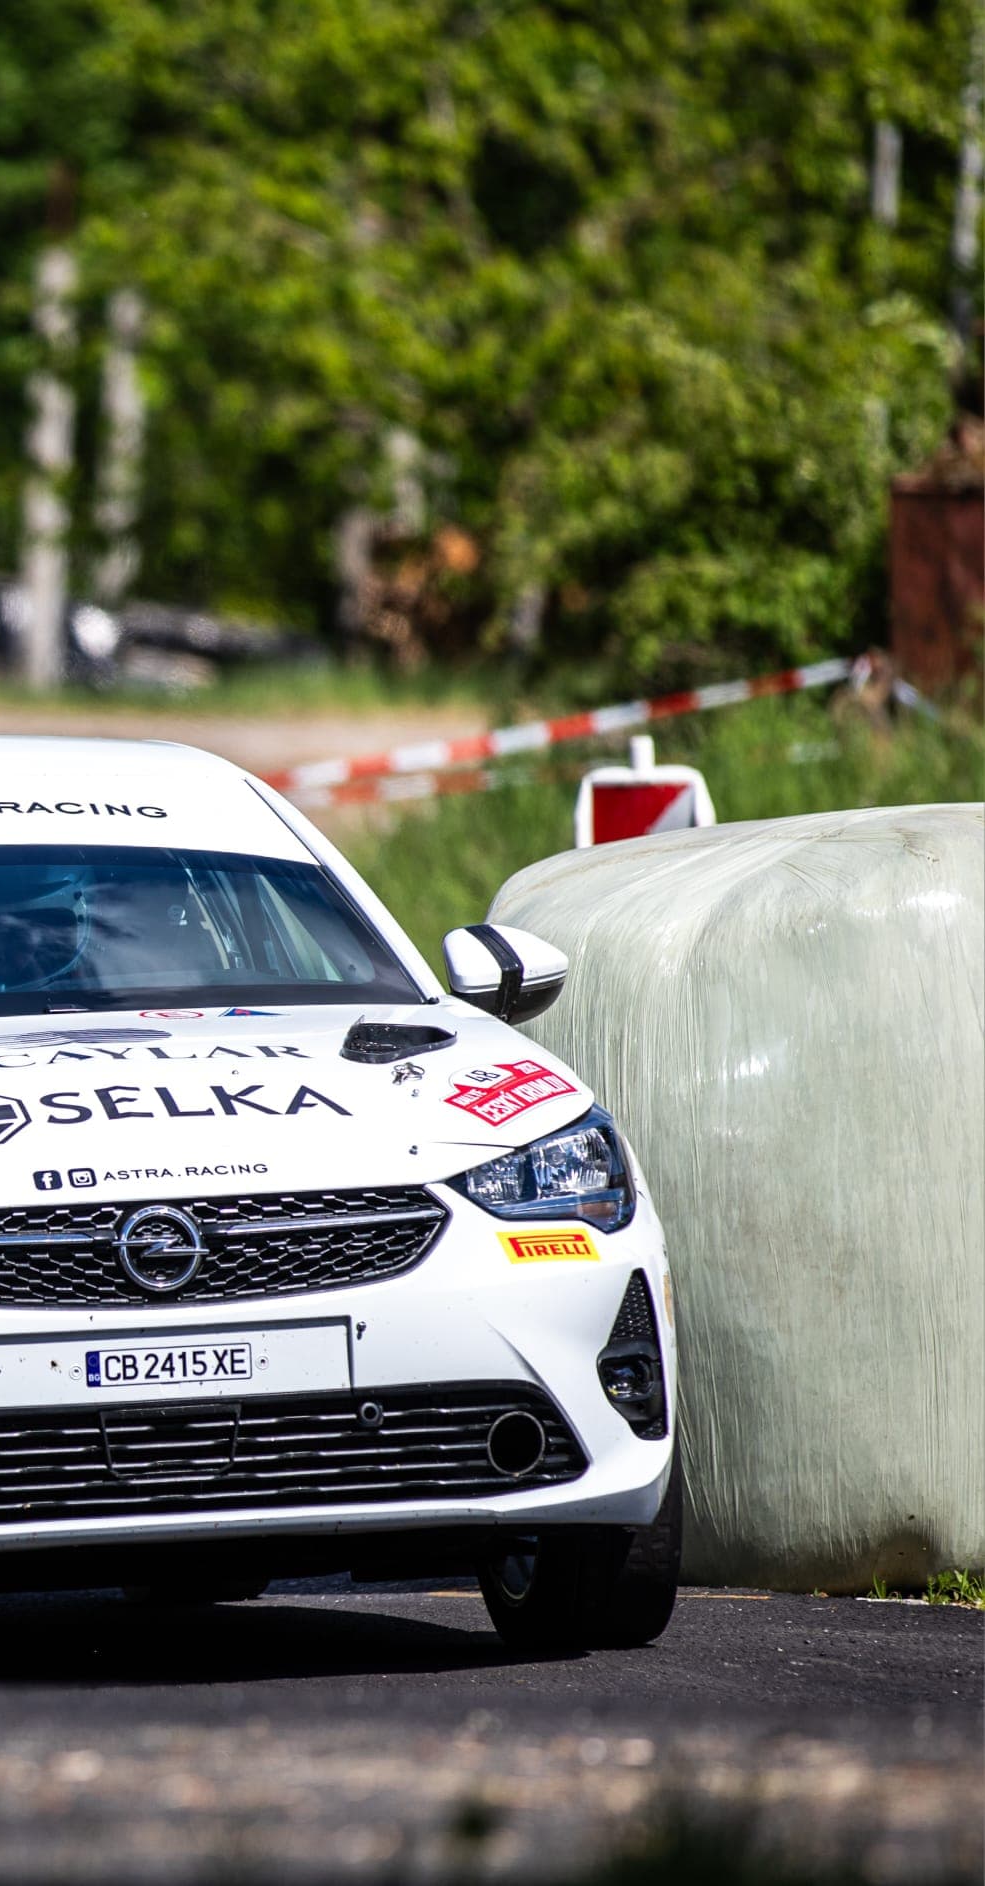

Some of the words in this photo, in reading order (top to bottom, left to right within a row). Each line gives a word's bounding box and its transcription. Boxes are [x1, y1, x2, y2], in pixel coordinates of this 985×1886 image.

[465, 1070, 501, 1082] 48
[39, 1085, 354, 1125] SELKA
[104, 1163, 268, 1181] ASTRA.RACING
[508, 1233, 591, 1258] PIRELLI
[88, 1374, 101, 1382] BG
